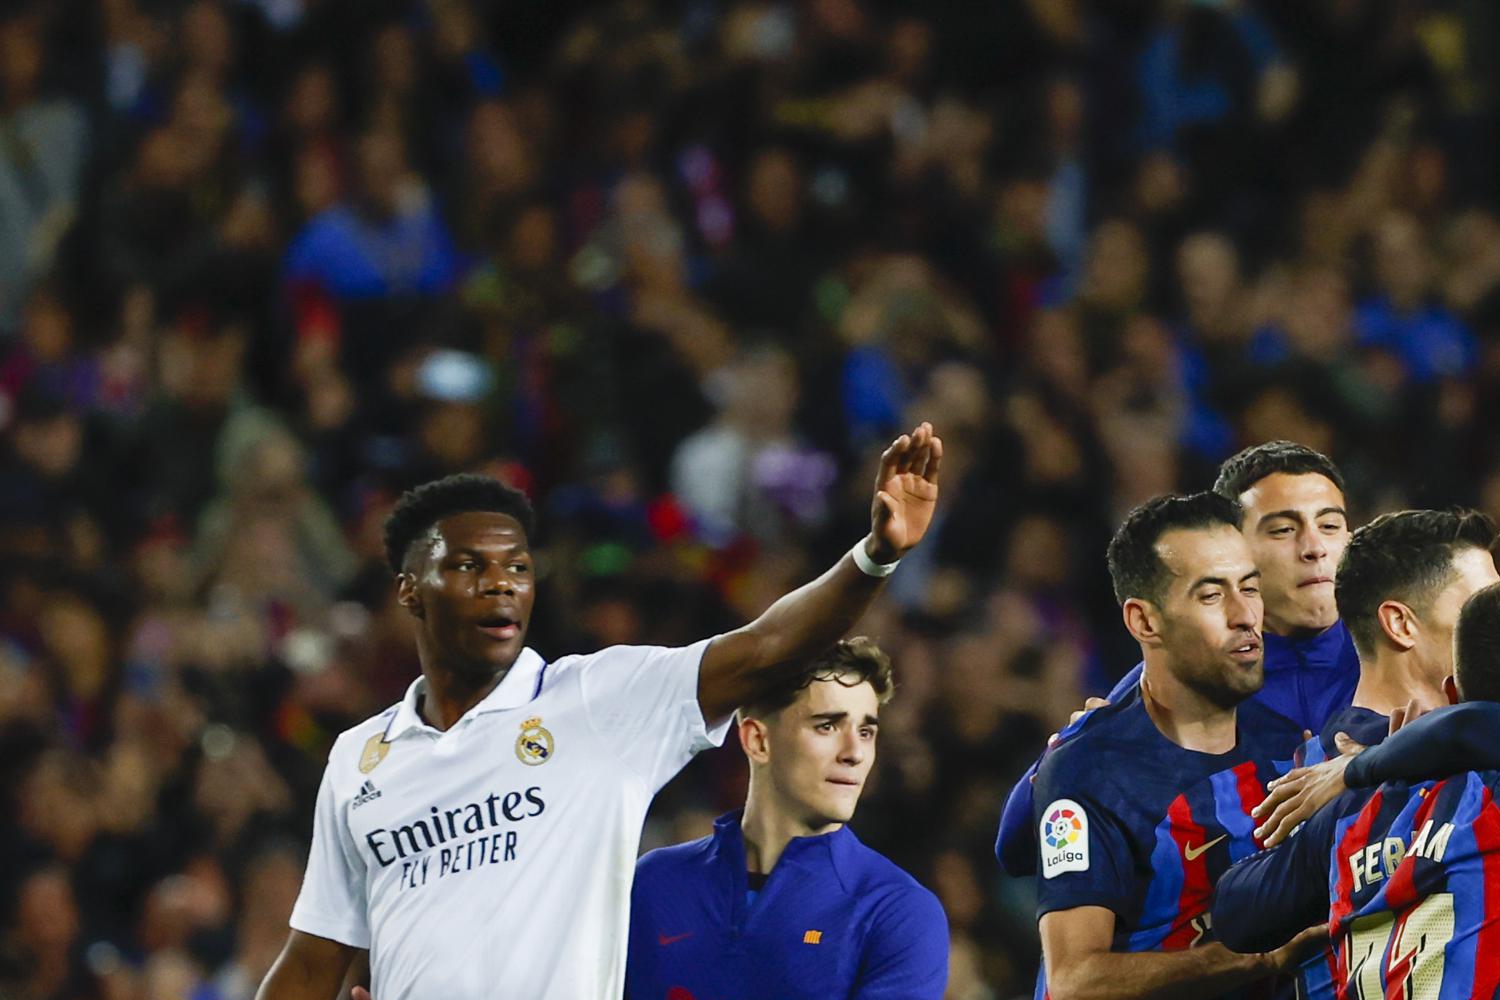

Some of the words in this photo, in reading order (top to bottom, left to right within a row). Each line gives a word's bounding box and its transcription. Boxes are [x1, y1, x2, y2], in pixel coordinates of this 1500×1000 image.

[366, 786, 545, 868] Emirates
[1047, 850, 1084, 867] LaLiga
[1349, 819, 1455, 893] FERAN
[400, 855, 431, 891] FLY
[440, 831, 518, 878] BETTER
